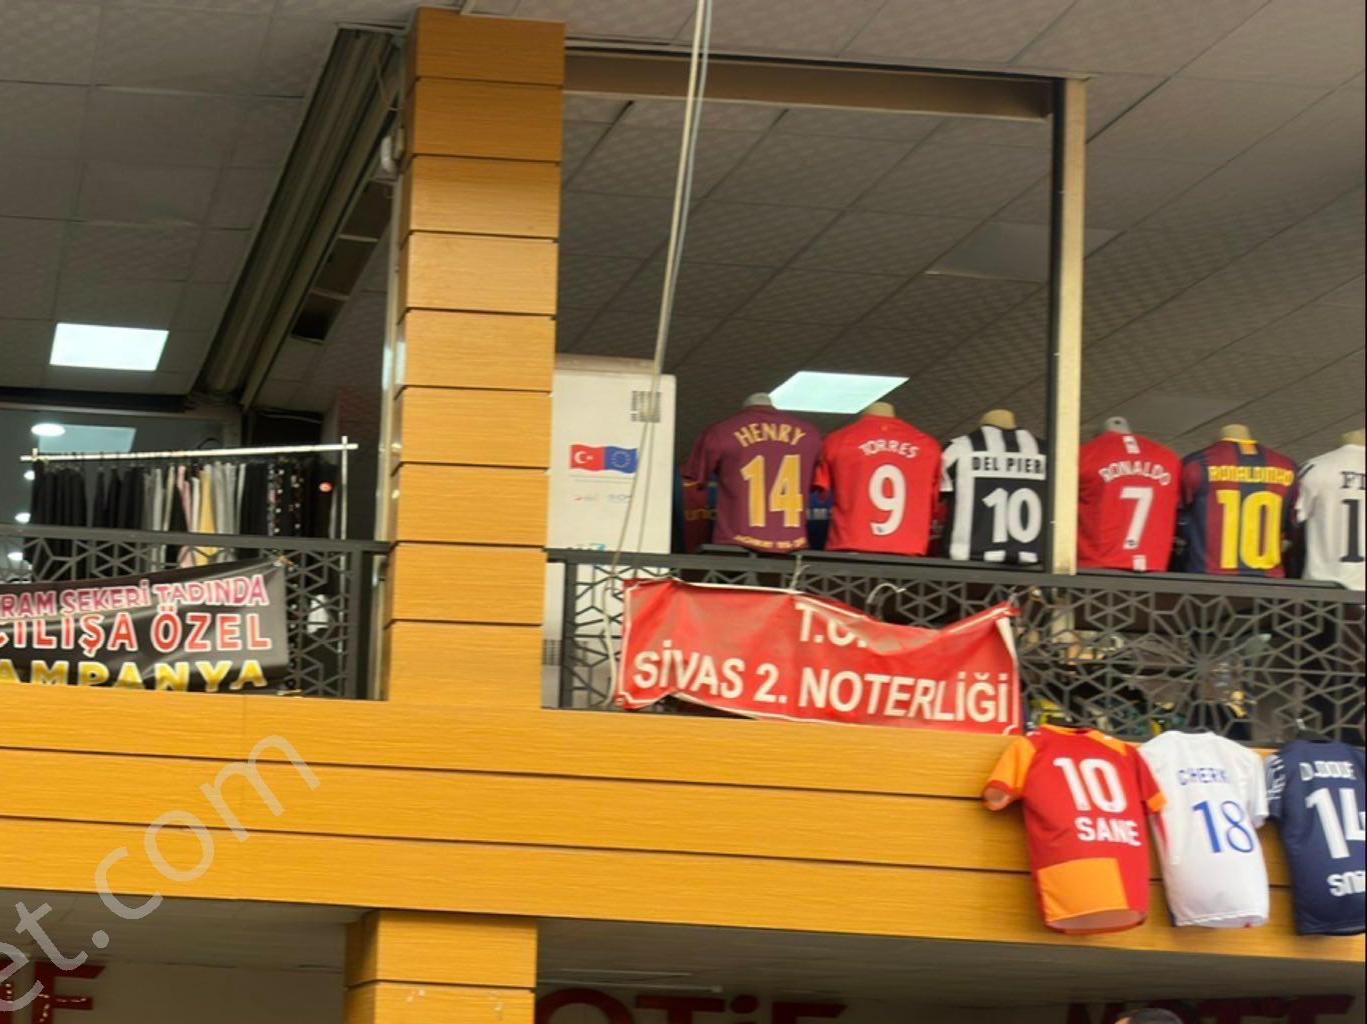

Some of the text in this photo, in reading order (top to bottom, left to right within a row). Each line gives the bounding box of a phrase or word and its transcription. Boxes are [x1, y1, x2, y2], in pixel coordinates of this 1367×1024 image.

[734, 422, 806, 448] HENRY
[858, 439, 920, 459] TORRES
[740, 453, 803, 527] 14
[972, 456, 1000, 471] DEL
[1097, 460, 1172, 487] RONALDO
[868, 463, 907, 536] 9
[981, 486, 1043, 544] 10
[1119, 486, 1154, 551] 7
[1216, 489, 1283, 570] 10
[152, 573, 271, 606] TADINDA
[150, 603, 273, 652] ÖZEL
[633, 640, 1010, 724] SİVAS 2. NOTERLİĞİ
[1052, 757, 1128, 813] 10
[1074, 817, 1142, 847] SANE
[1191, 799, 1255, 853] 18
